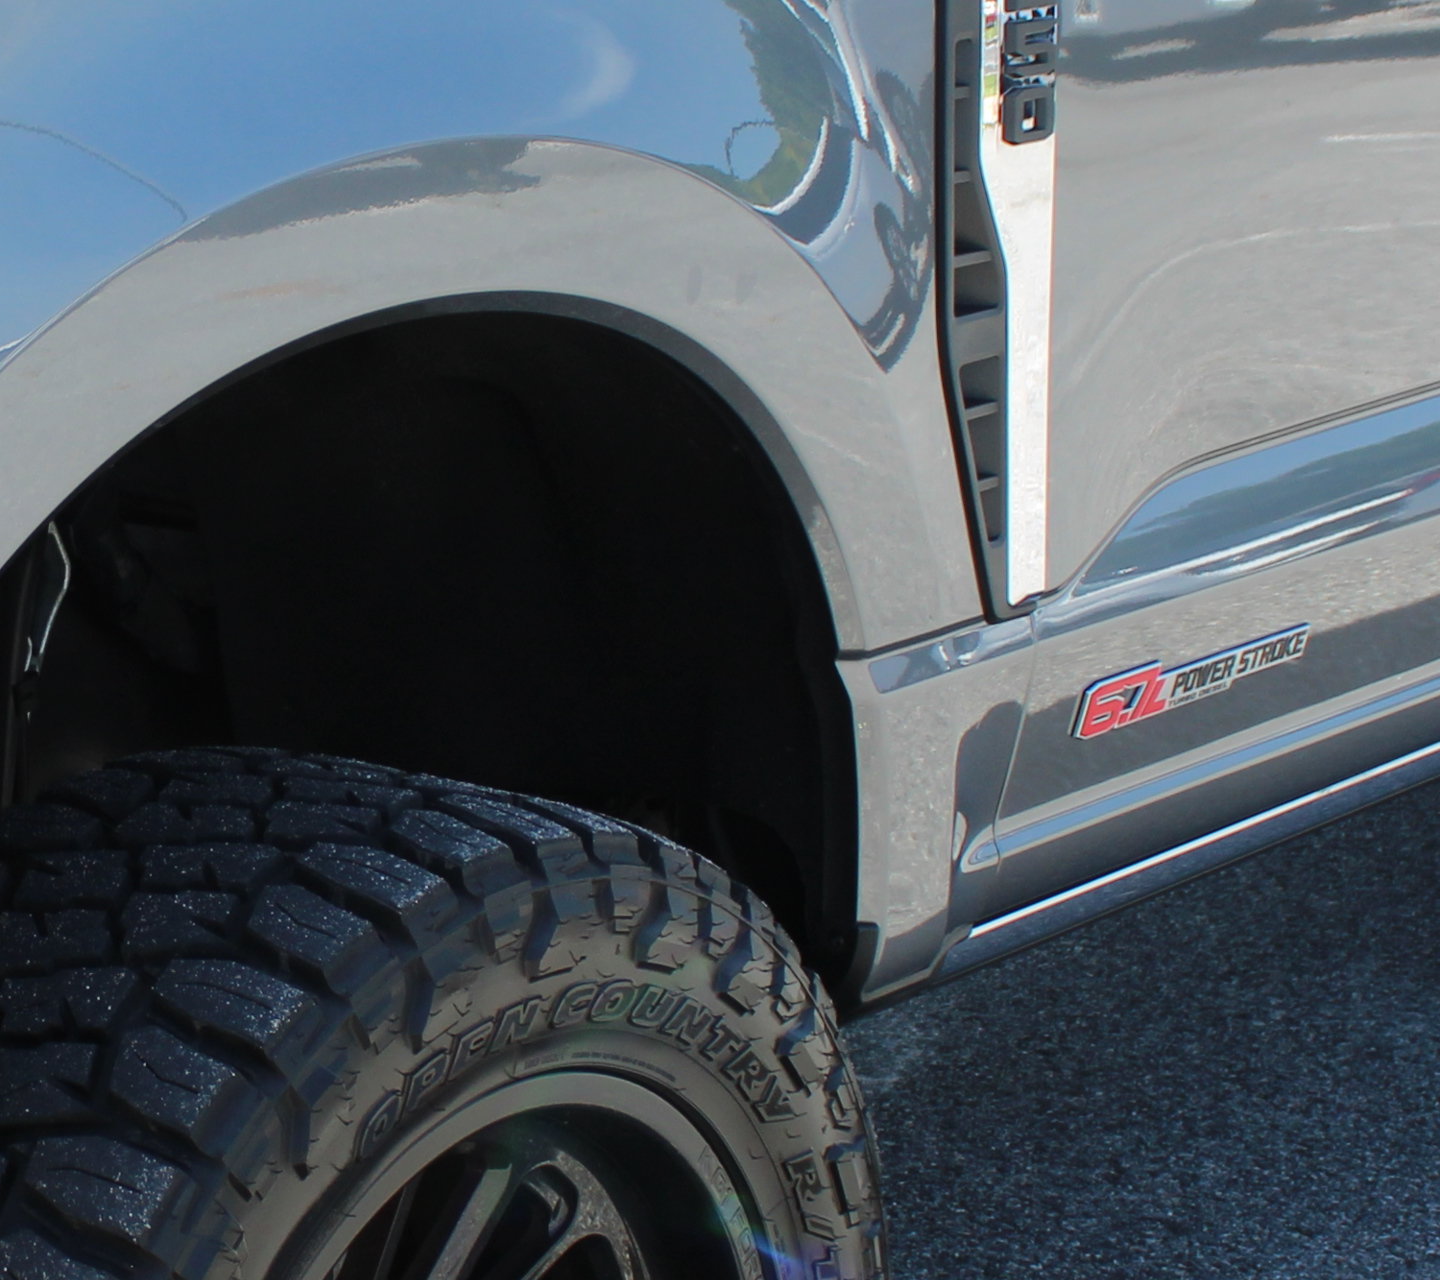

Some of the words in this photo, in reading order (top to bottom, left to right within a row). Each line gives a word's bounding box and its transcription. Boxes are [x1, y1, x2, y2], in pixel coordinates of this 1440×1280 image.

[1079, 666, 1169, 740] 6.7L
[1171, 654, 1237, 698] POWER
[1237, 630, 1308, 674] STROKE
[353, 996, 538, 1161] OPEN
[550, 979, 798, 1122] COUNTRY
